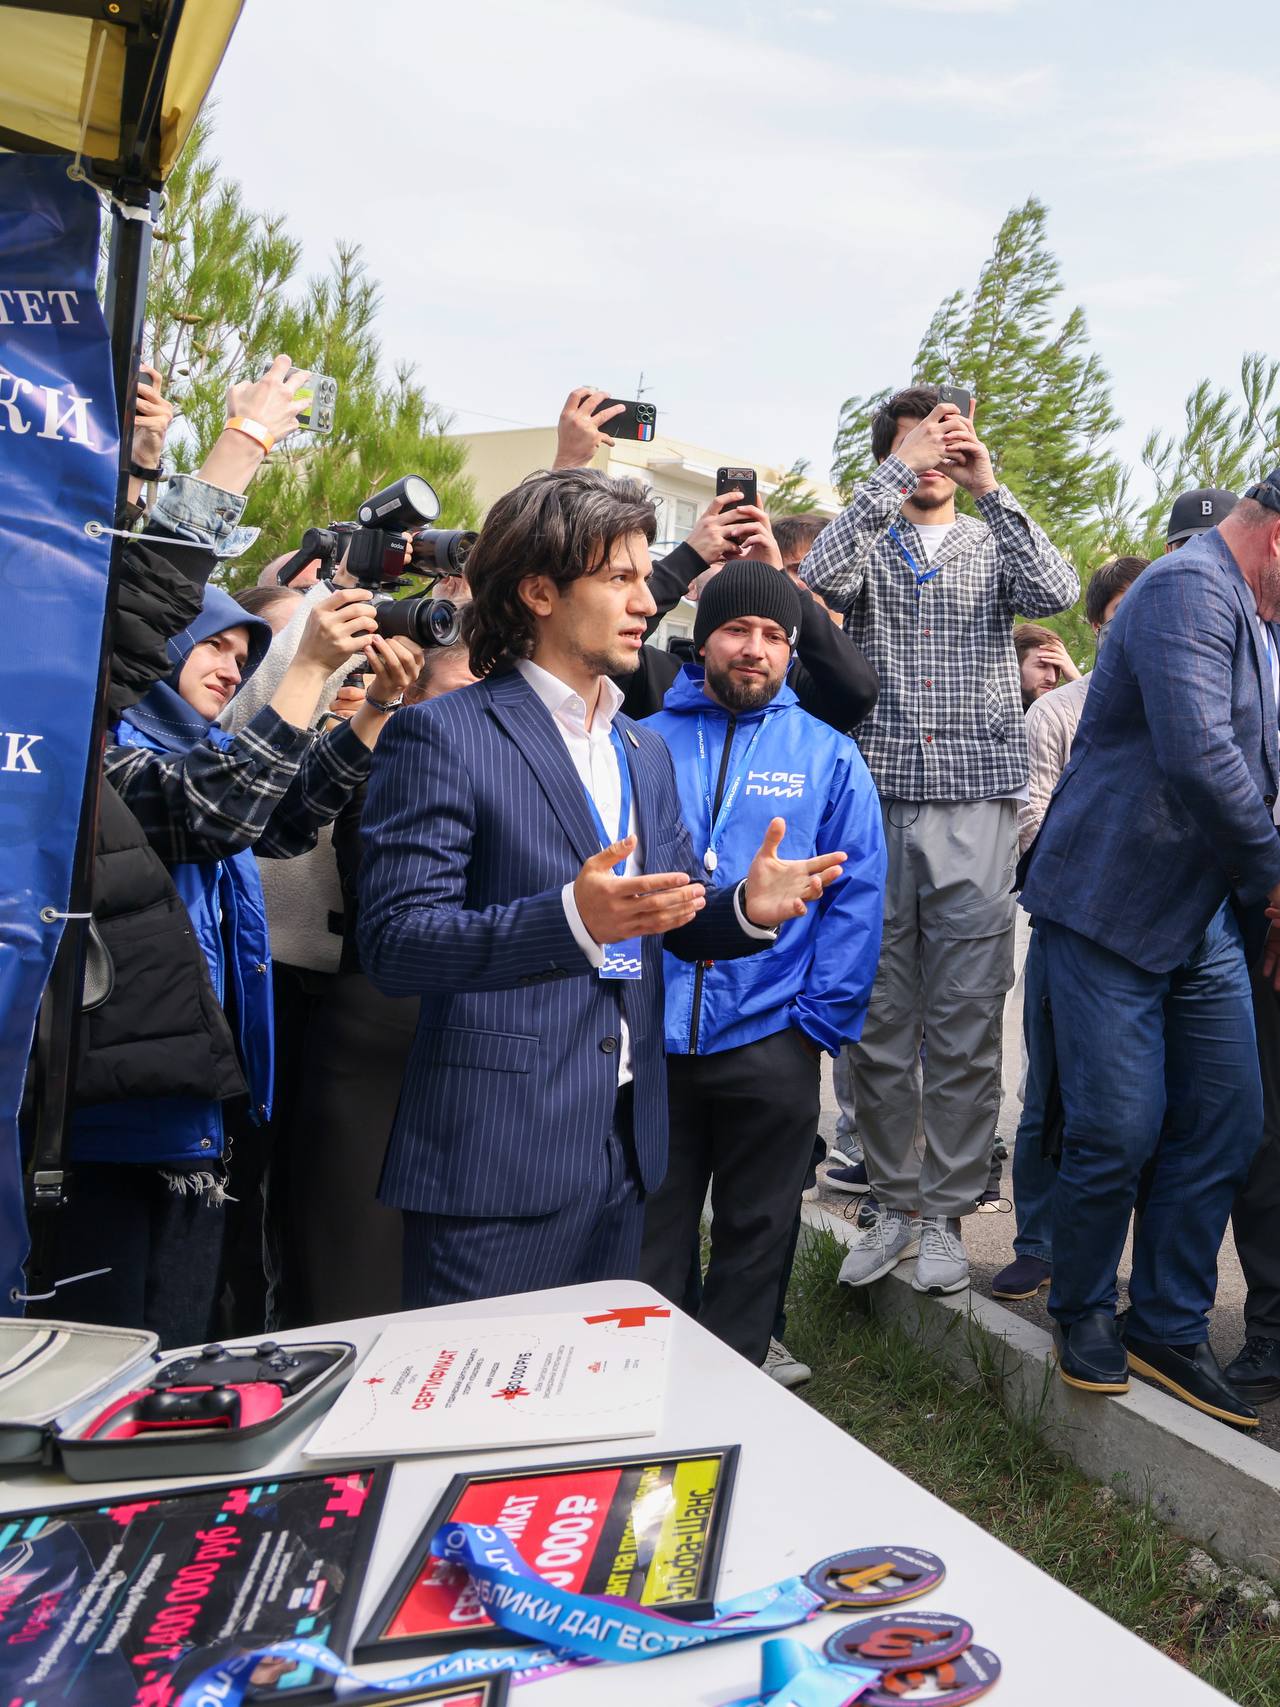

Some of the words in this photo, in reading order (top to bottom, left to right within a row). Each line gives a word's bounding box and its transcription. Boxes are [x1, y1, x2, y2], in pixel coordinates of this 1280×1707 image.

[1201, 500, 1213, 515] B
[411, 1349, 459, 1411] СЕРТИФИКАТ
[164, 1562, 221, 1603] 000
[194, 1526, 242, 1562] руб
